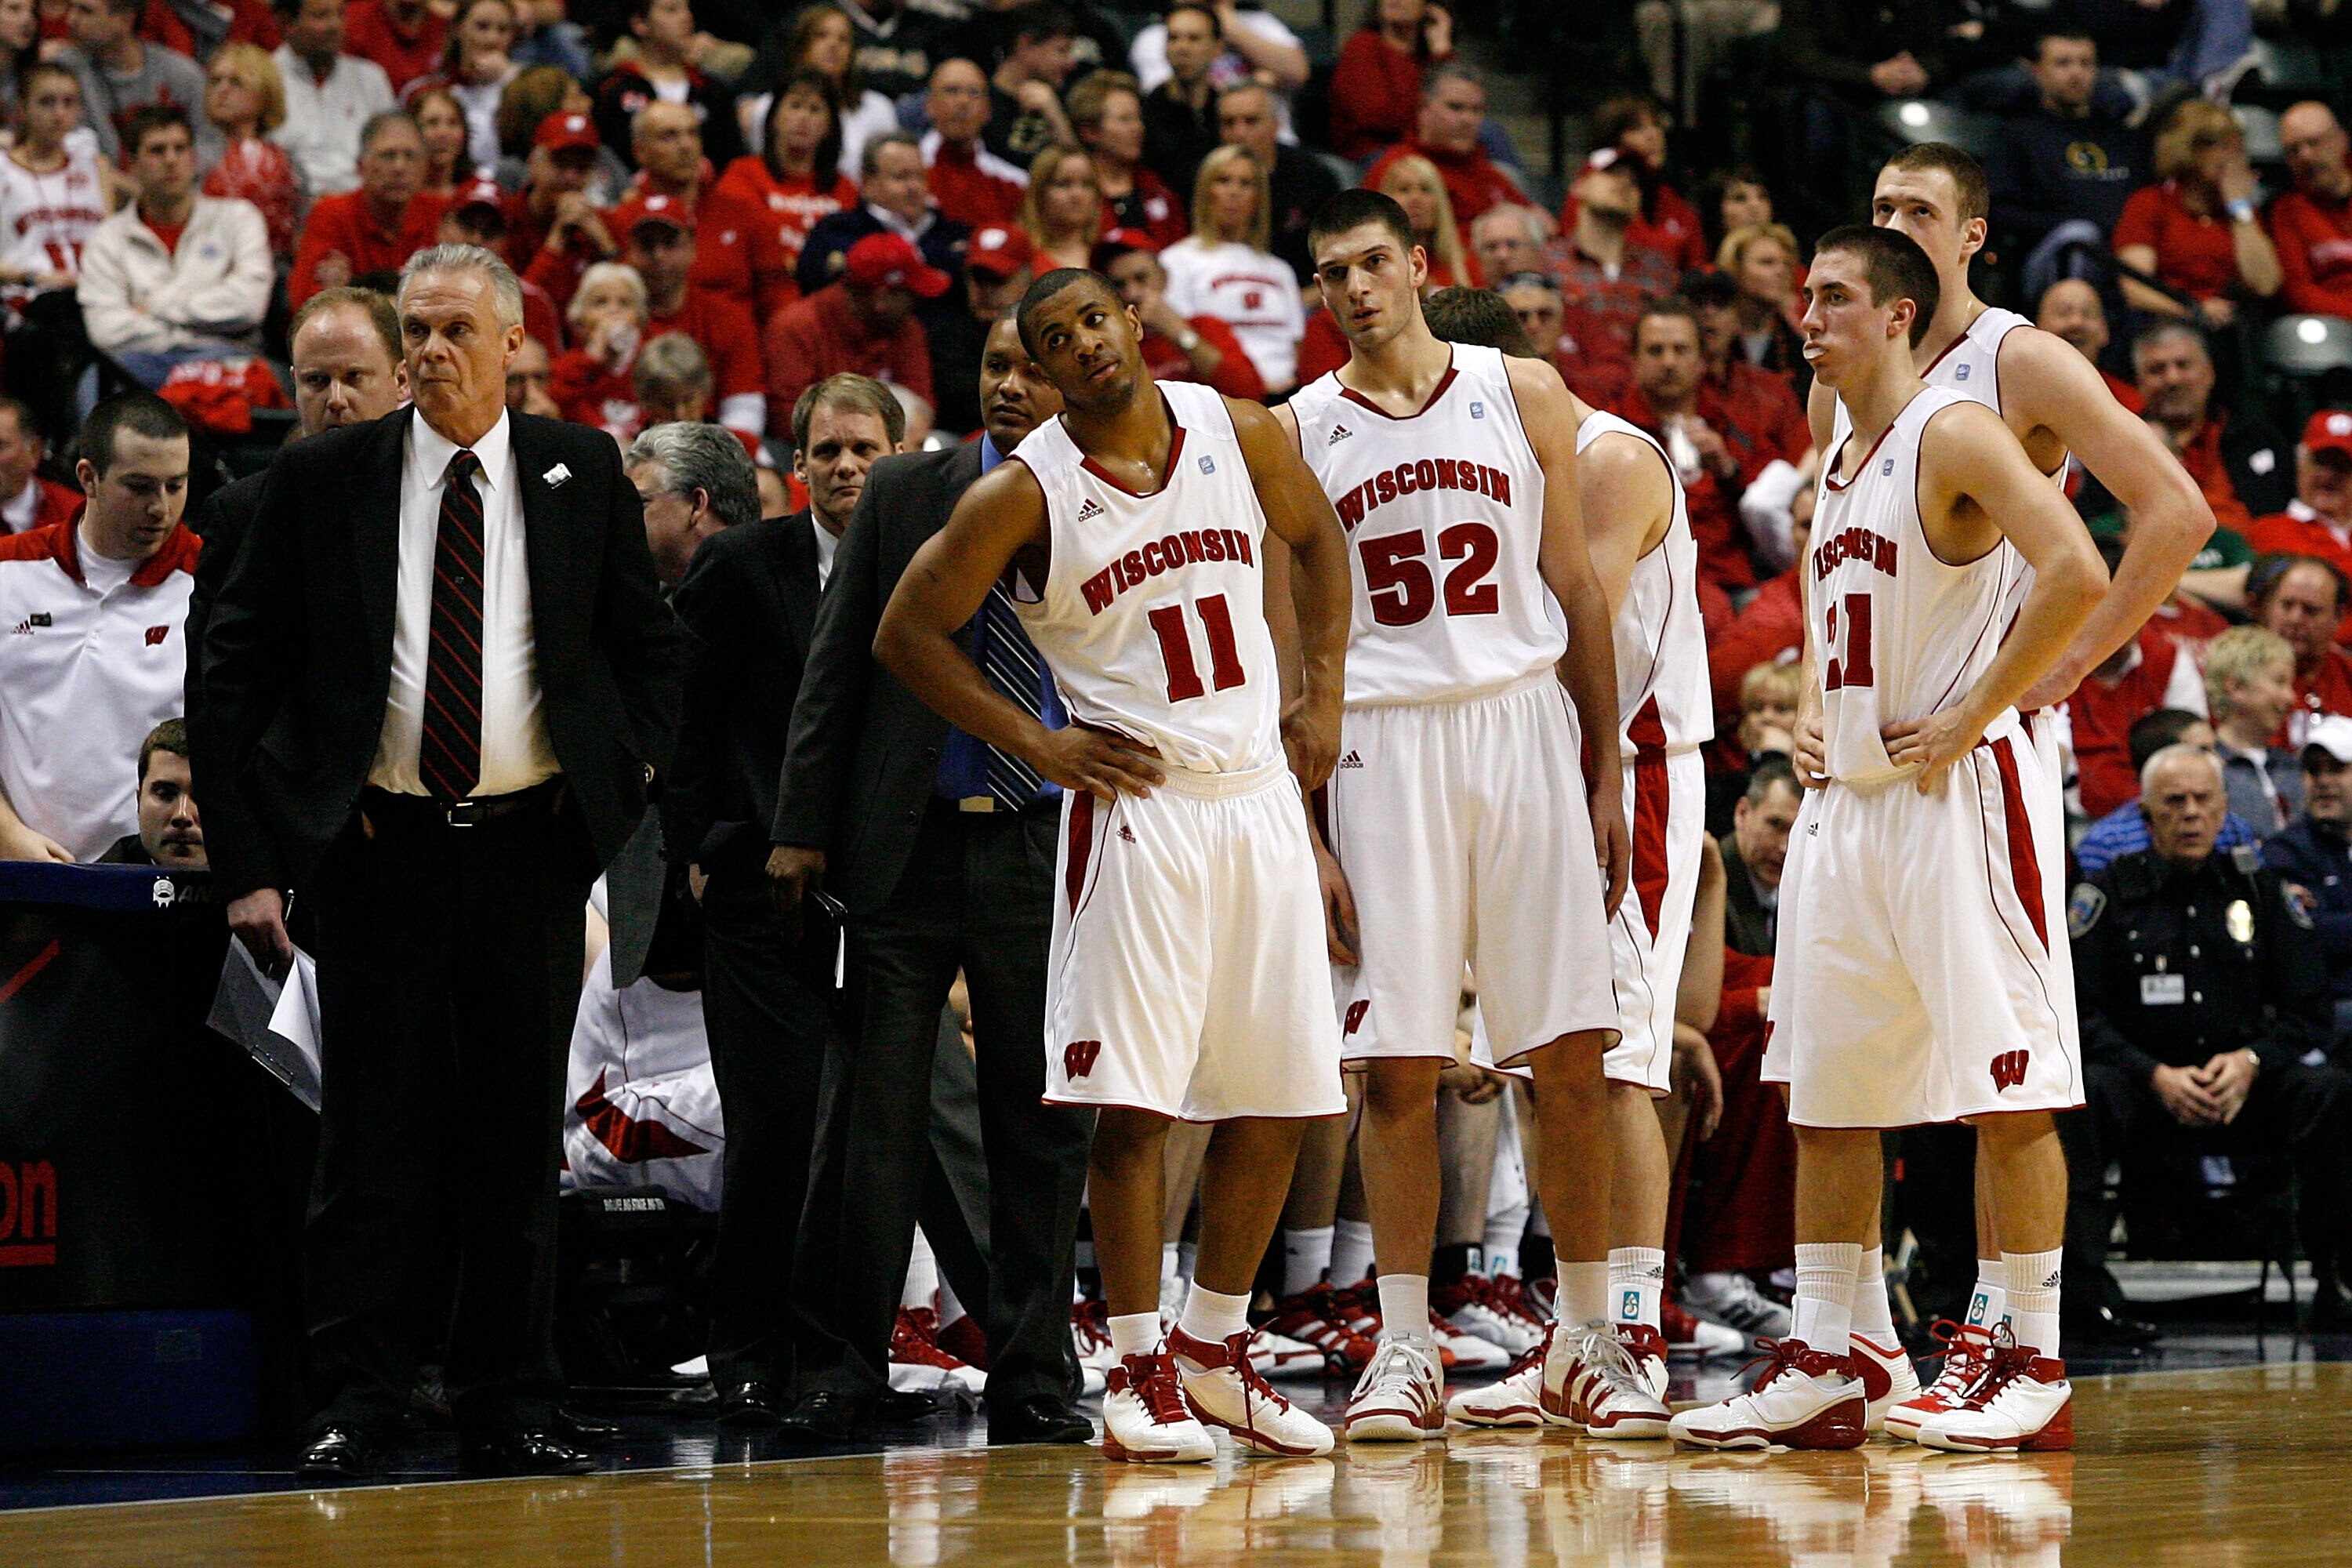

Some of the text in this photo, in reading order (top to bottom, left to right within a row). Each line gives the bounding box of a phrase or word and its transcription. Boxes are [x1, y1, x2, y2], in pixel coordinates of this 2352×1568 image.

[1328, 431, 1353, 446] adidas
[1078, 507, 1105, 522] adidas
[1335, 458, 1512, 533] WISCONSIN
[1080, 528, 1254, 616] WISCONSIN
[1358, 522, 1500, 626] 52
[1813, 527, 1897, 590] ISCNSN
[1148, 593, 1247, 703] 11
[1063, 1040, 1102, 1083] W
[1990, 1049, 2030, 1094] W
